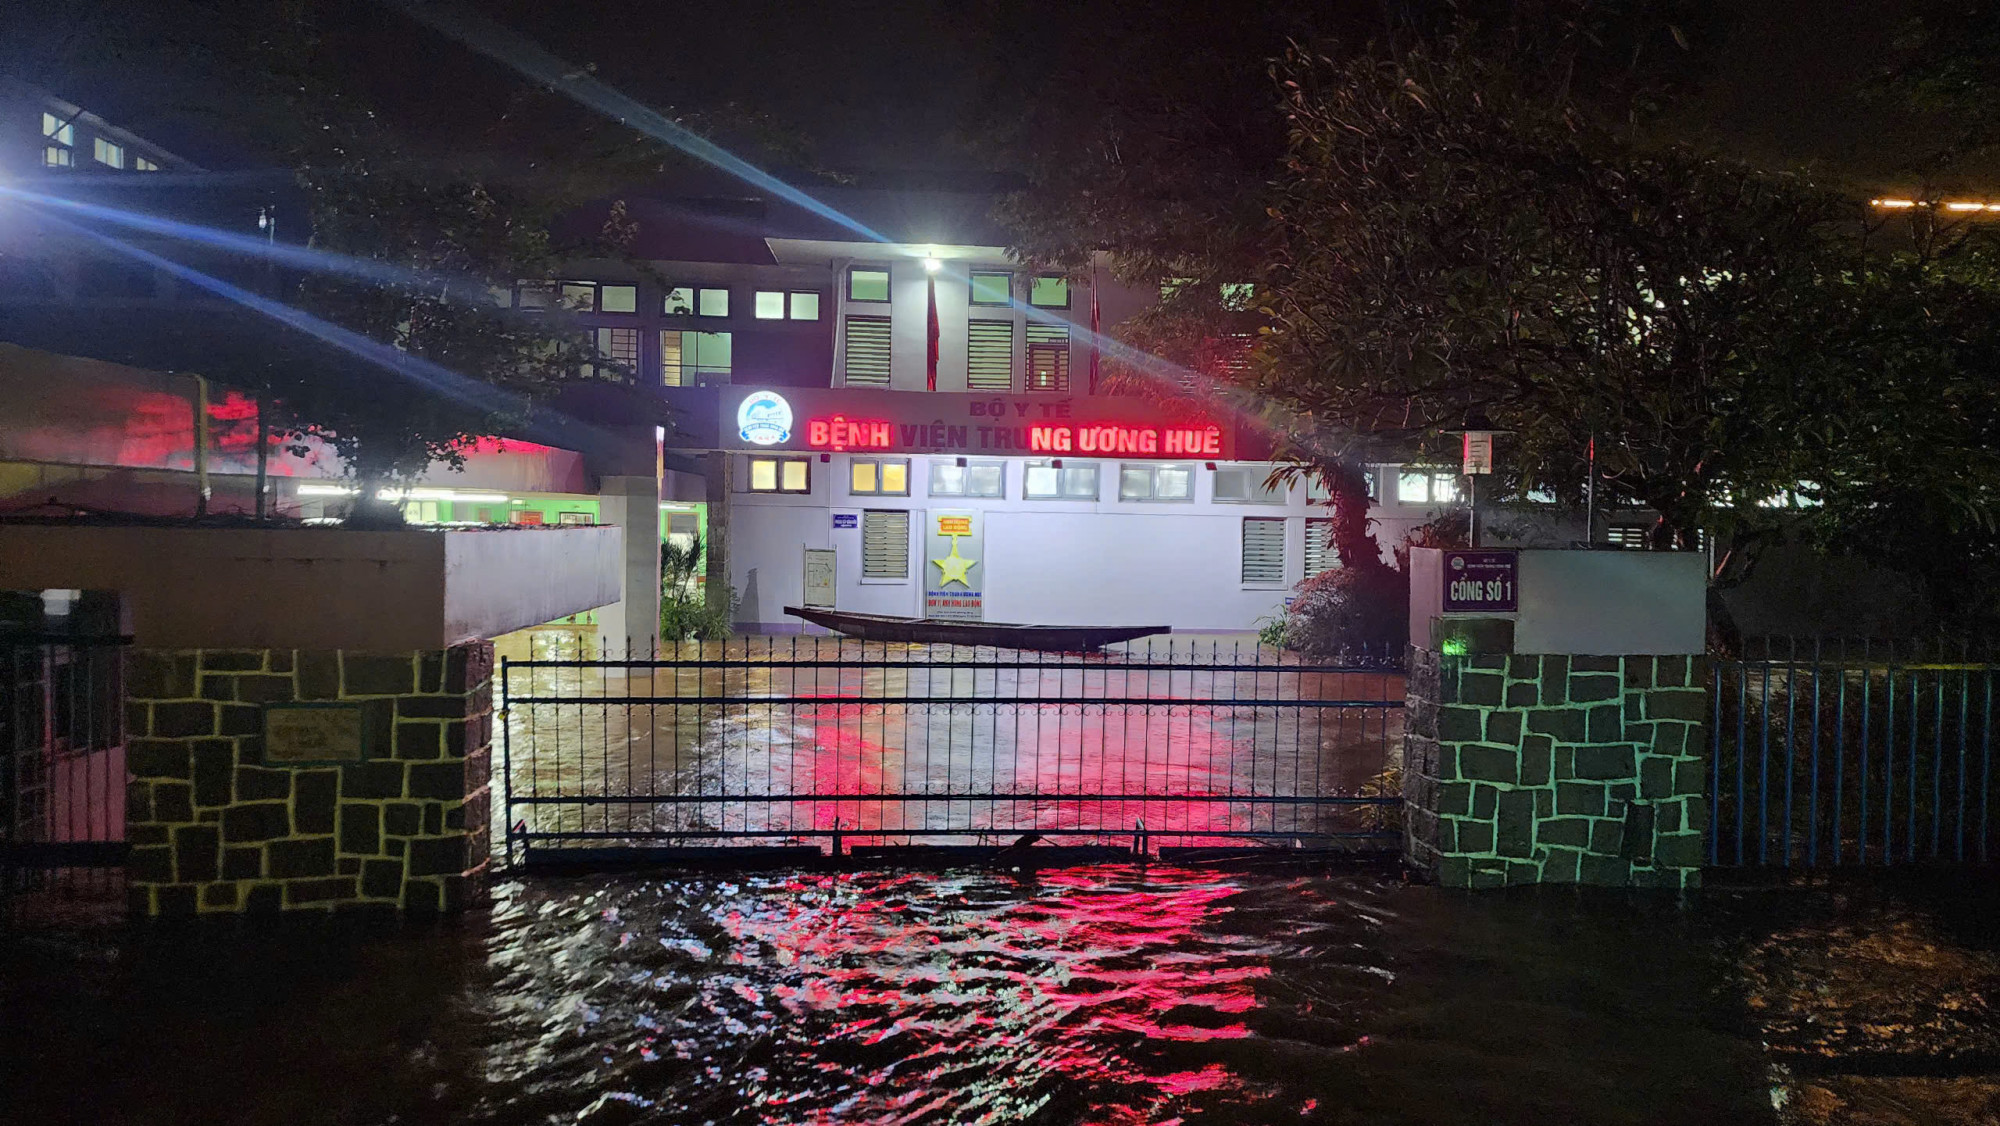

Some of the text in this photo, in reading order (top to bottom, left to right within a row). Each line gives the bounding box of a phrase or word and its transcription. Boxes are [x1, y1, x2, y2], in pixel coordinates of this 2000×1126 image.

[969, 398, 1073, 421] BỘ Y TẾ
[809, 416, 890, 451] BỆNH
[900, 419, 967, 451] VIỆN
[977, 425, 1072, 451] TRUNG
[1079, 426, 1157, 453] ƯƠNG
[1450, 572, 1511, 601] CỔNG SỐ 1
